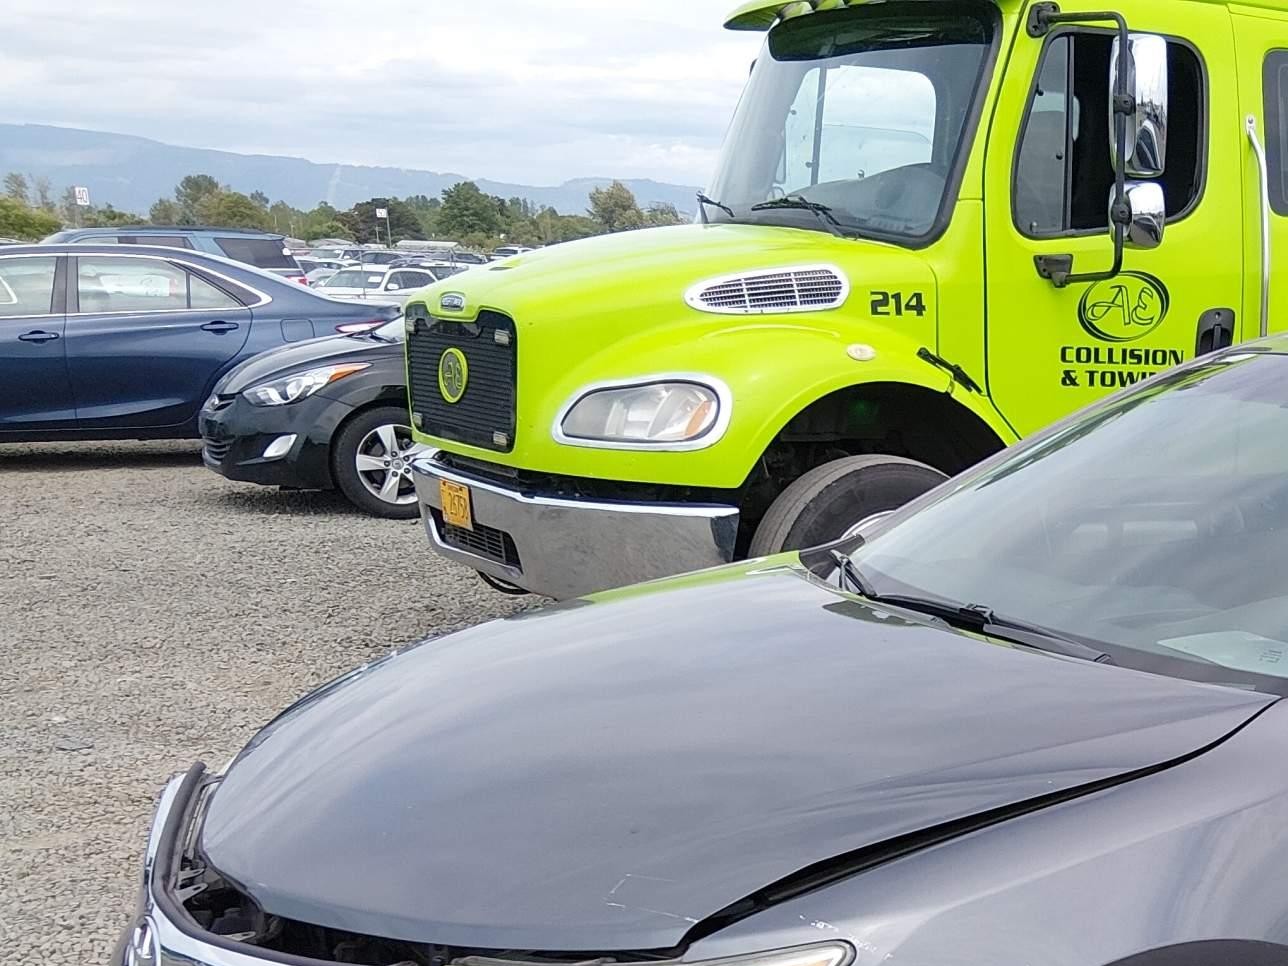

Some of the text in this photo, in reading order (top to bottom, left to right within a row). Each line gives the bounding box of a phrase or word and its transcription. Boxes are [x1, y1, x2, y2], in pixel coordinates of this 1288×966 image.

[870, 291, 927, 316] 214
[1060, 346, 1184, 366] COLLISION
[1061, 370, 1157, 387] & TOW
